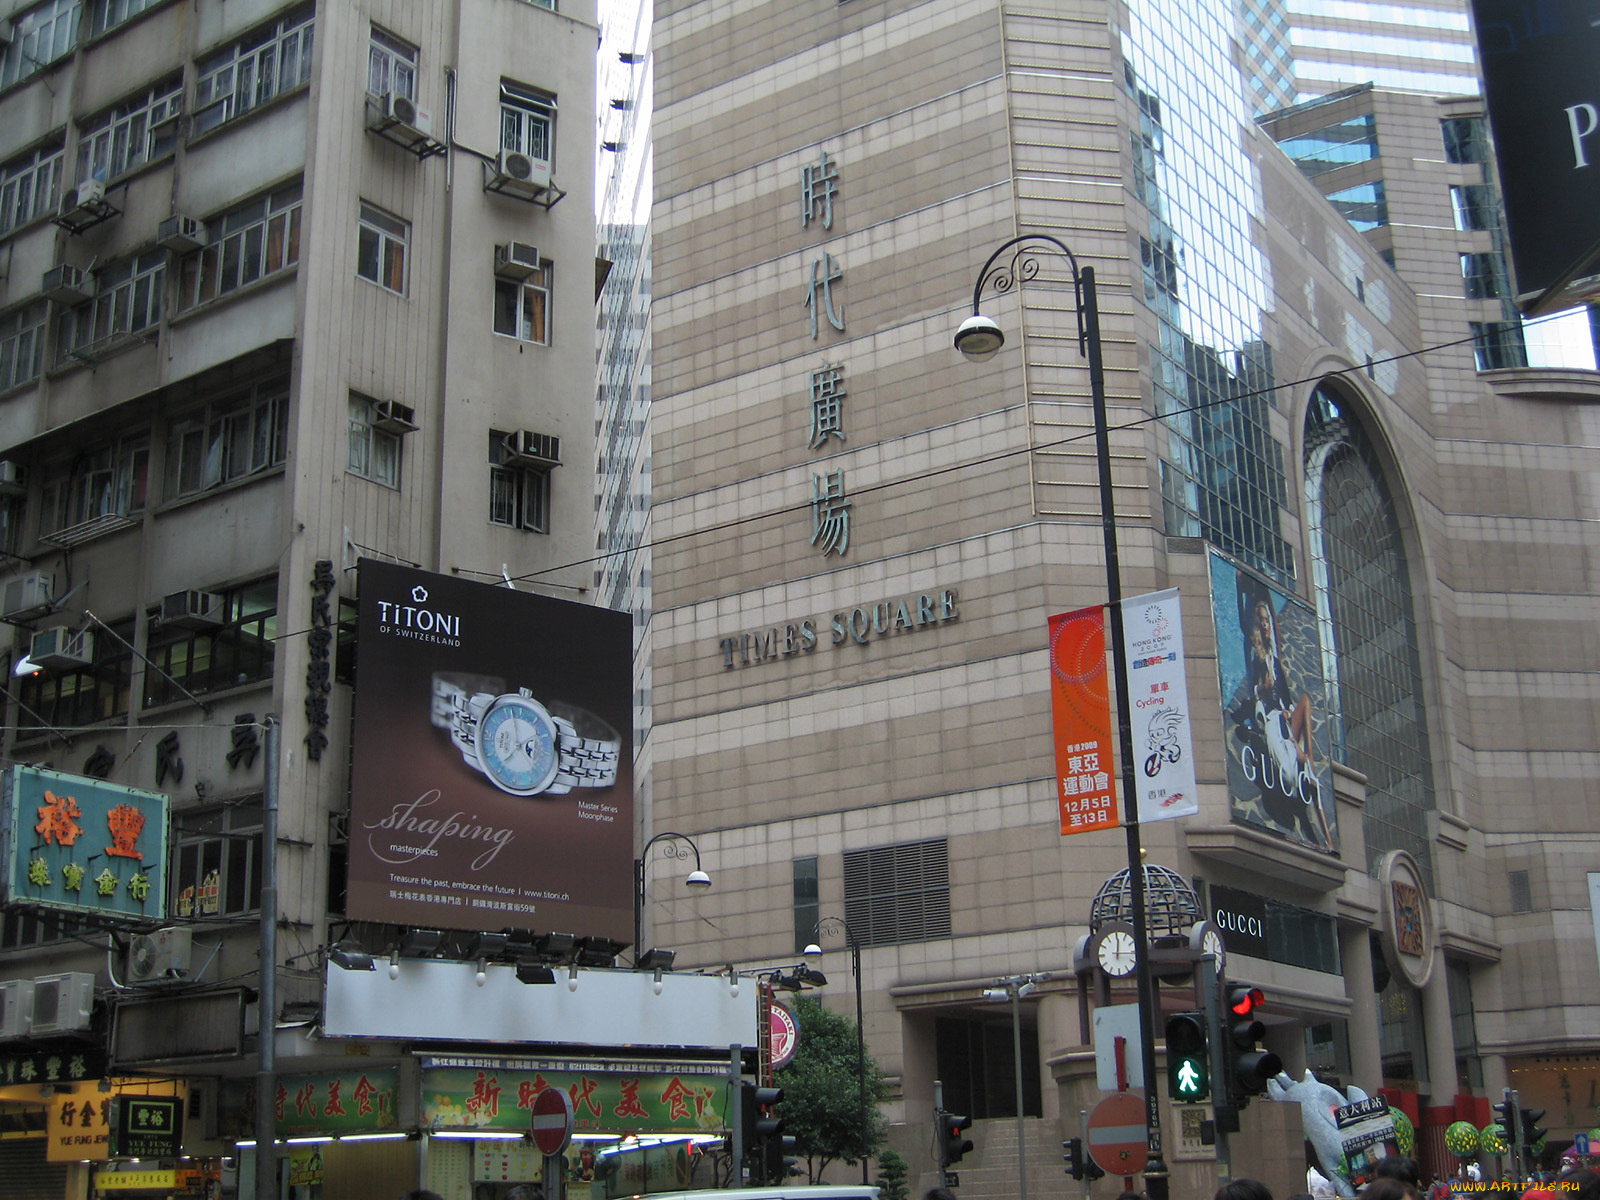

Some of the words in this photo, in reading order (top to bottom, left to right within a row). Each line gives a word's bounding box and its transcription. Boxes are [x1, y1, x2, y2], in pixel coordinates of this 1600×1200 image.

[802, 150, 852, 558] 時代廣場
[380, 625, 391, 634] OF
[396, 628, 461, 648] SWITZERLAND
[719, 618, 817, 668] TIMES
[832, 588, 960, 645] SQUARE
[1132, 639, 1151, 648] HONG
[1153, 635, 1172, 643] KONG
[1136, 697, 1165, 708] Cycling
[1068, 753, 1100, 774] 東亞
[1063, 771, 1109, 796] 運動會
[1241, 745, 1323, 810] GUCCI
[578, 801, 599, 812] Master
[600, 804, 618, 813] Series
[1064, 795, 1111, 813] 12月5日
[35, 790, 146, 860] 裕豐
[578, 811, 614, 823] Moonphase
[1070, 810, 1108, 827] 至13日
[363, 789, 515, 870] shaping
[390, 843, 438, 857] masterpieces
[389, 873, 419, 885] Treasure
[421, 876, 432, 886] the
[433, 879, 450, 888] past,
[452, 881, 481, 892] embrace
[482, 884, 493, 892] the
[494, 885, 515, 895] future
[524, 889, 570, 901] www.titoni.ch
[1216, 908, 1263, 938] GUCCI
[774, 1007, 793, 1036] TAIYAKI
[1339, 1096, 1382, 1119] 意大利站
[129, 1140, 146, 1148] YUE
[149, 1140, 173, 1148] FUNG
